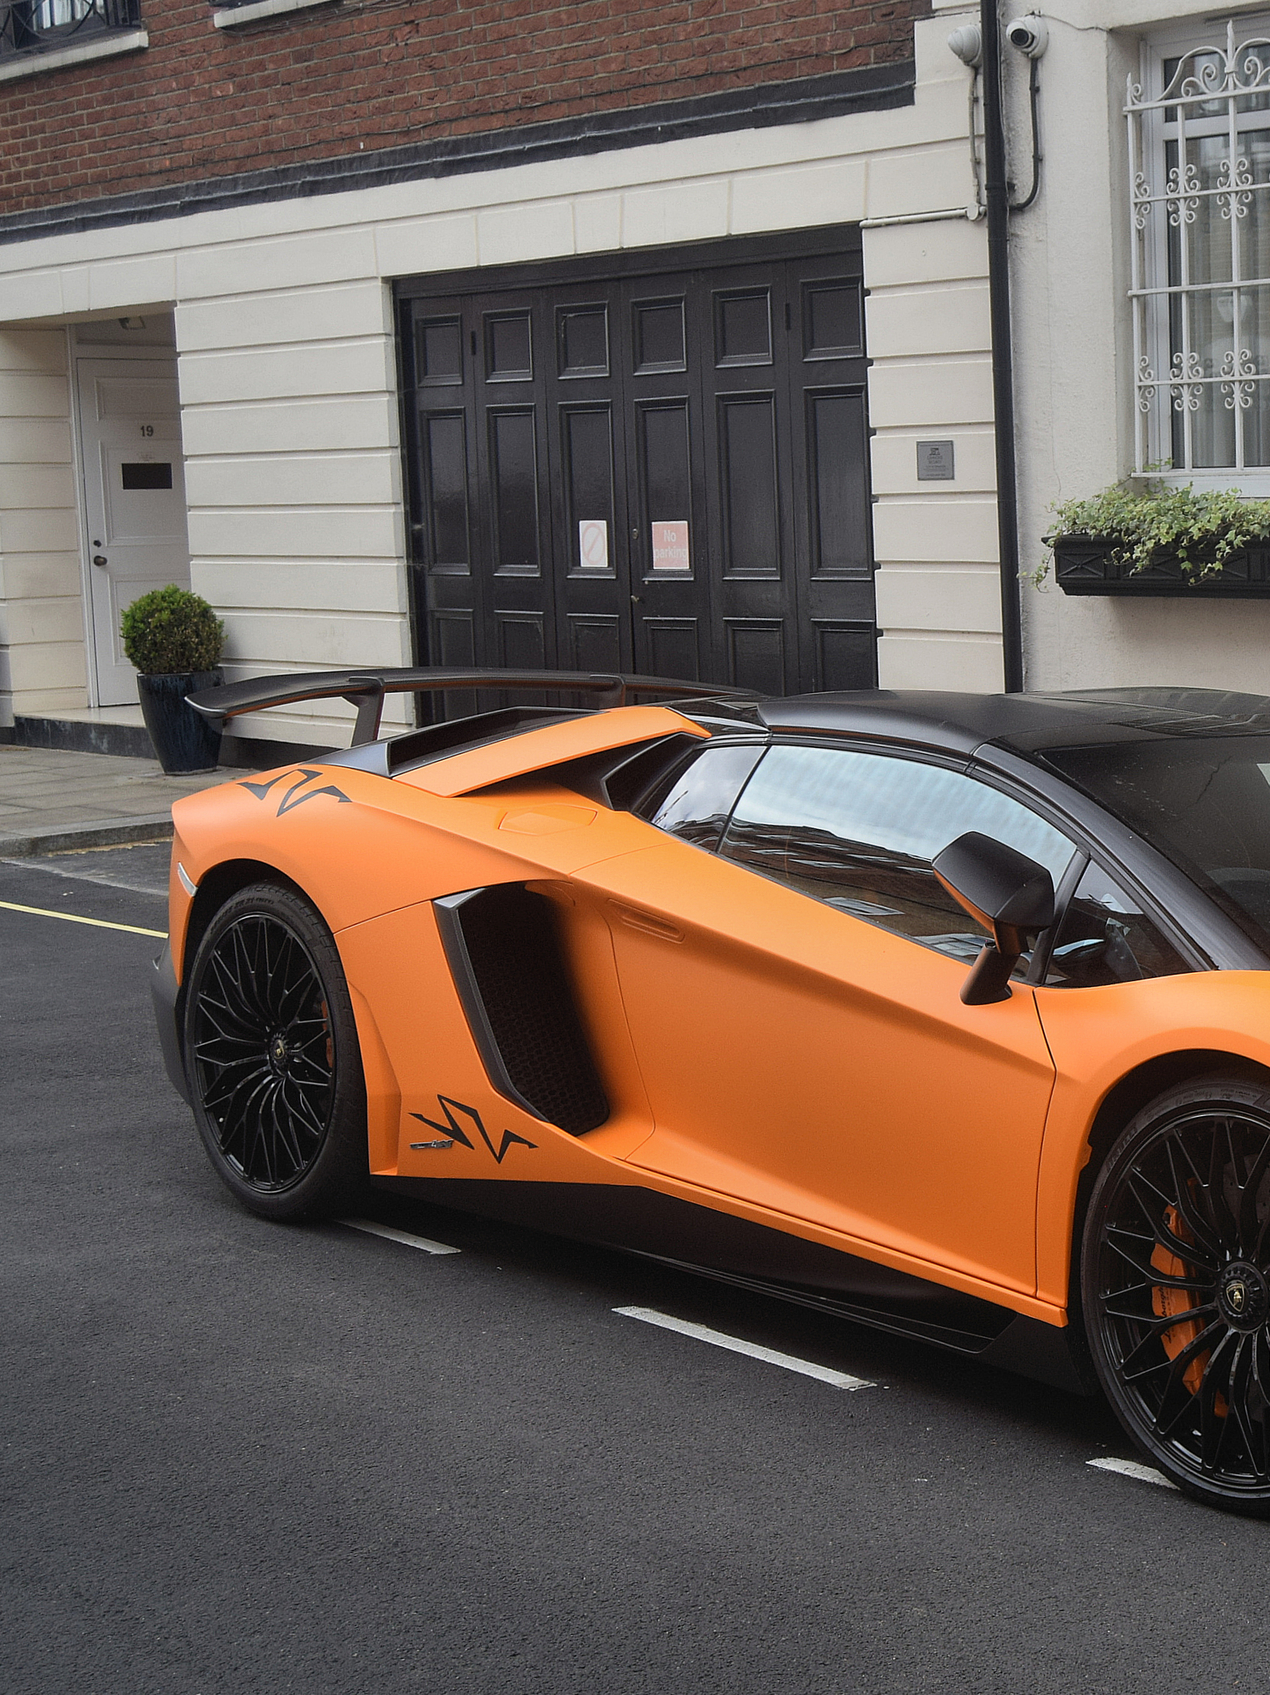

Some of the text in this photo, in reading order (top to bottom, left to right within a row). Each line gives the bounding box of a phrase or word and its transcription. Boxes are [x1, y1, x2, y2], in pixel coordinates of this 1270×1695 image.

[141, 425, 154, 437] 19
[663, 529, 677, 542] No
[655, 546, 687, 561] parking
